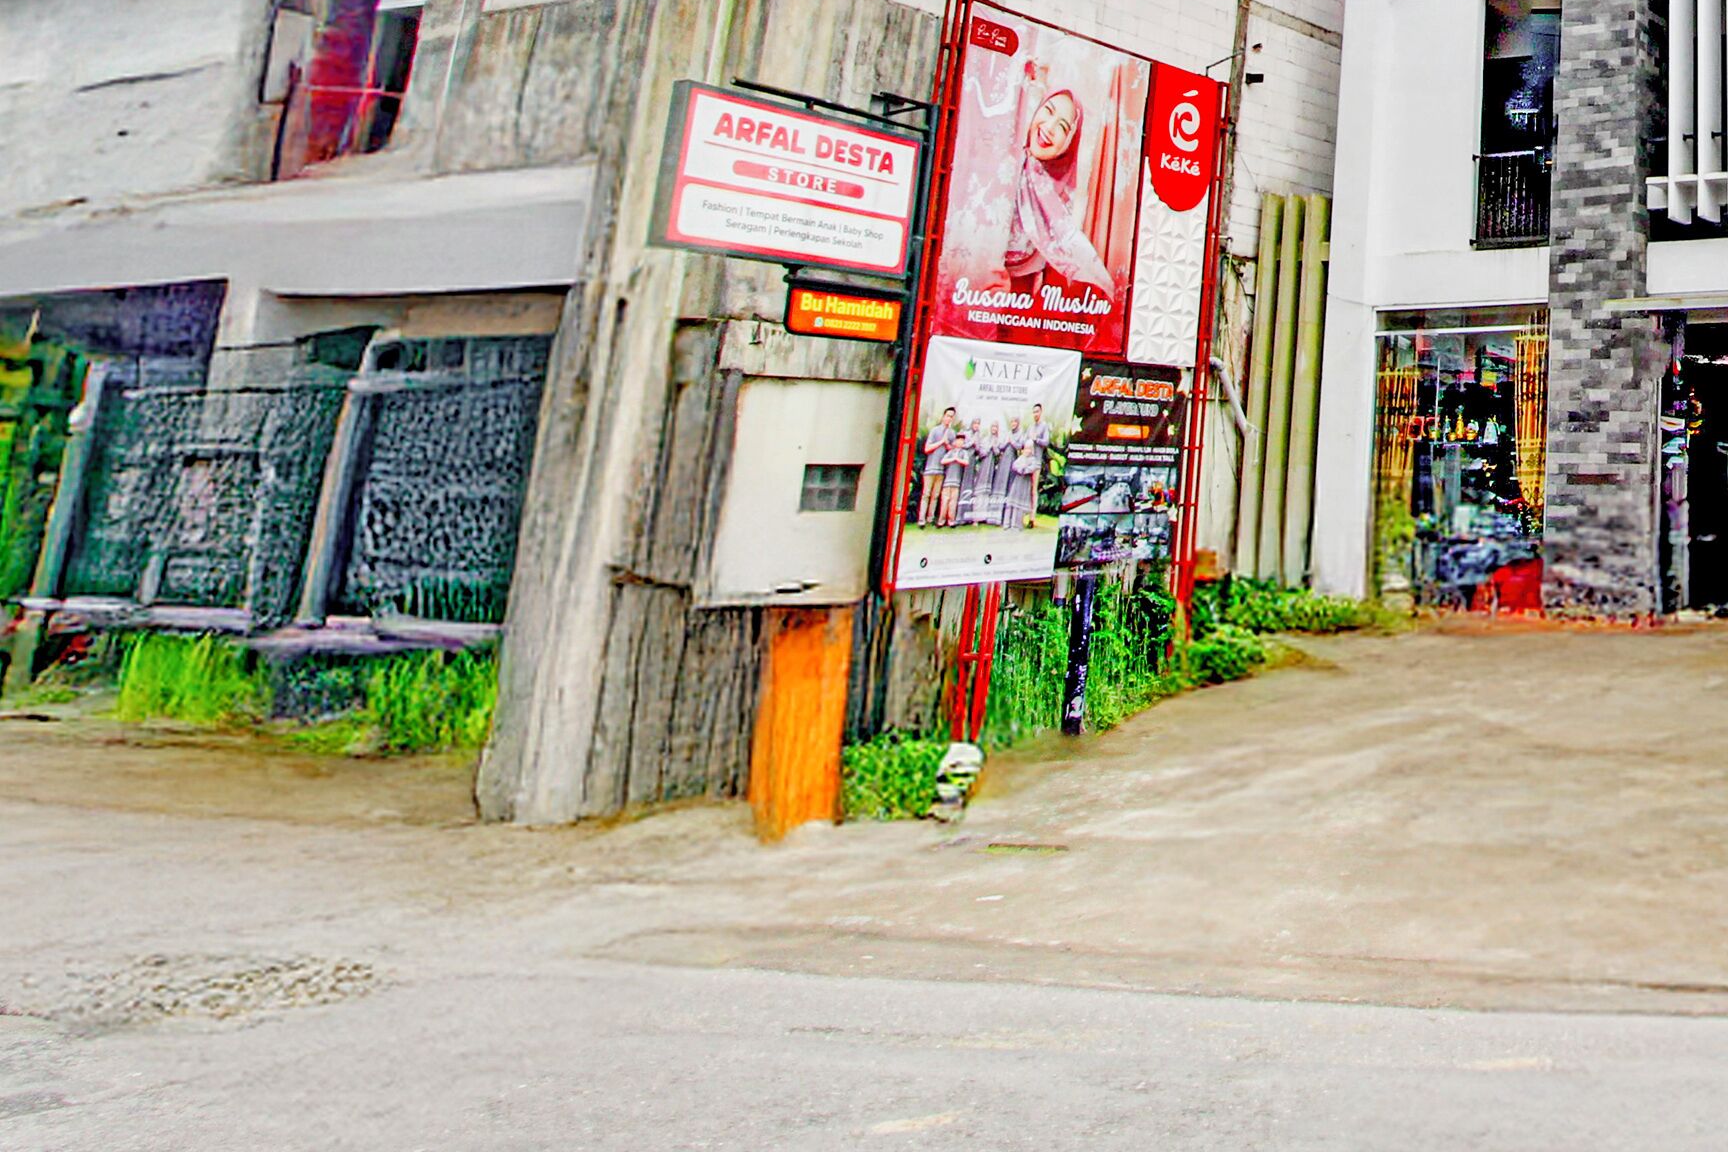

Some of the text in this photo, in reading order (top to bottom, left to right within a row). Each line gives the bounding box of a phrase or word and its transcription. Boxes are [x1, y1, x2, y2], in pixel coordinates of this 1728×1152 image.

[713, 112, 894, 175] ARFAL DESTA
[767, 167, 838, 194] STORE
[702, 200, 884, 241] Fashion Tempat Bermain Anak Baby Shop
[725, 218, 863, 249] Seragam Perlengkapan Sekolah
[800, 292, 894, 321] Bu Hamidah
[952, 277, 1111, 315] Busana Muslim
[967, 310, 1095, 335] KEBANGGAAN INDONESIA
[982, 361, 1044, 381] NAFIS
[1090, 375, 1175, 402] ARFAL DESTA
